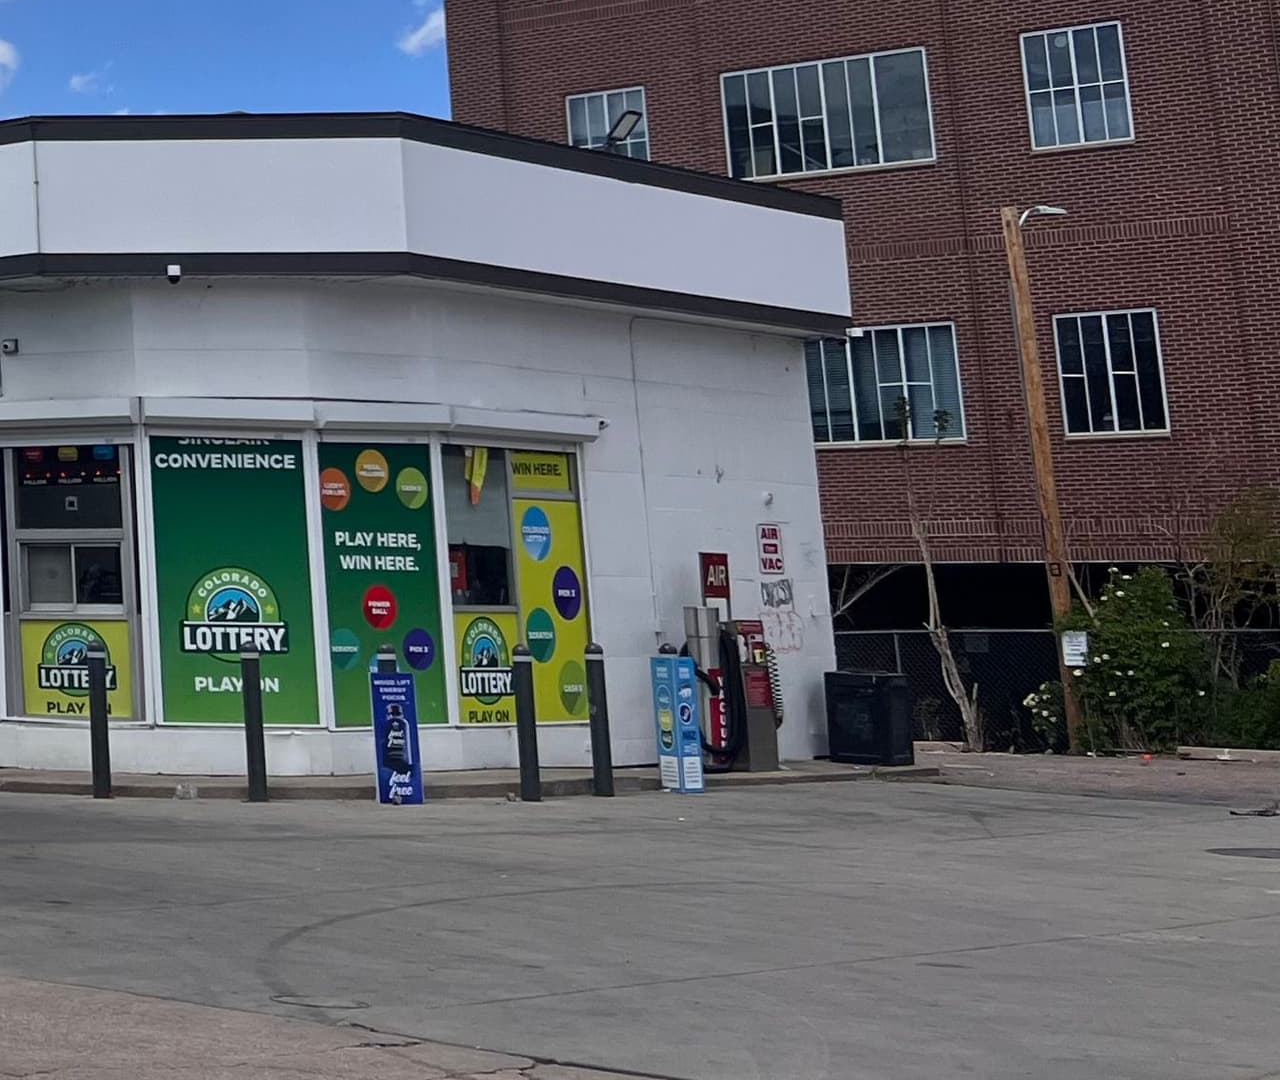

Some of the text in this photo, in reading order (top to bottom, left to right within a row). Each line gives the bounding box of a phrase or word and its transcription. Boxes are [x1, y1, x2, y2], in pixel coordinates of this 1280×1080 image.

[155, 453, 296, 469] CONVENIENCE
[511, 462, 532, 475] WIN
[335, 531, 422, 551] PLAY HERE,
[760, 528, 778, 540] AIR
[340, 555, 420, 571] WIN HERE.
[761, 558, 784, 570] VAC
[707, 565, 727, 586] AIR
[197, 573, 267, 598] COLORADO
[50, 628, 96, 647] COLORAD
[183, 626, 286, 651] LOTTERY
[467, 623, 502, 646] COLORADO
[40, 668, 114, 689] LOTTEY
[194, 676, 280, 693] PLAY N
[461, 671, 512, 694] LOTTERY
[47, 702, 86, 714] PLAY
[469, 710, 509, 723] PLAY ON
[389, 770, 411, 786] feel
